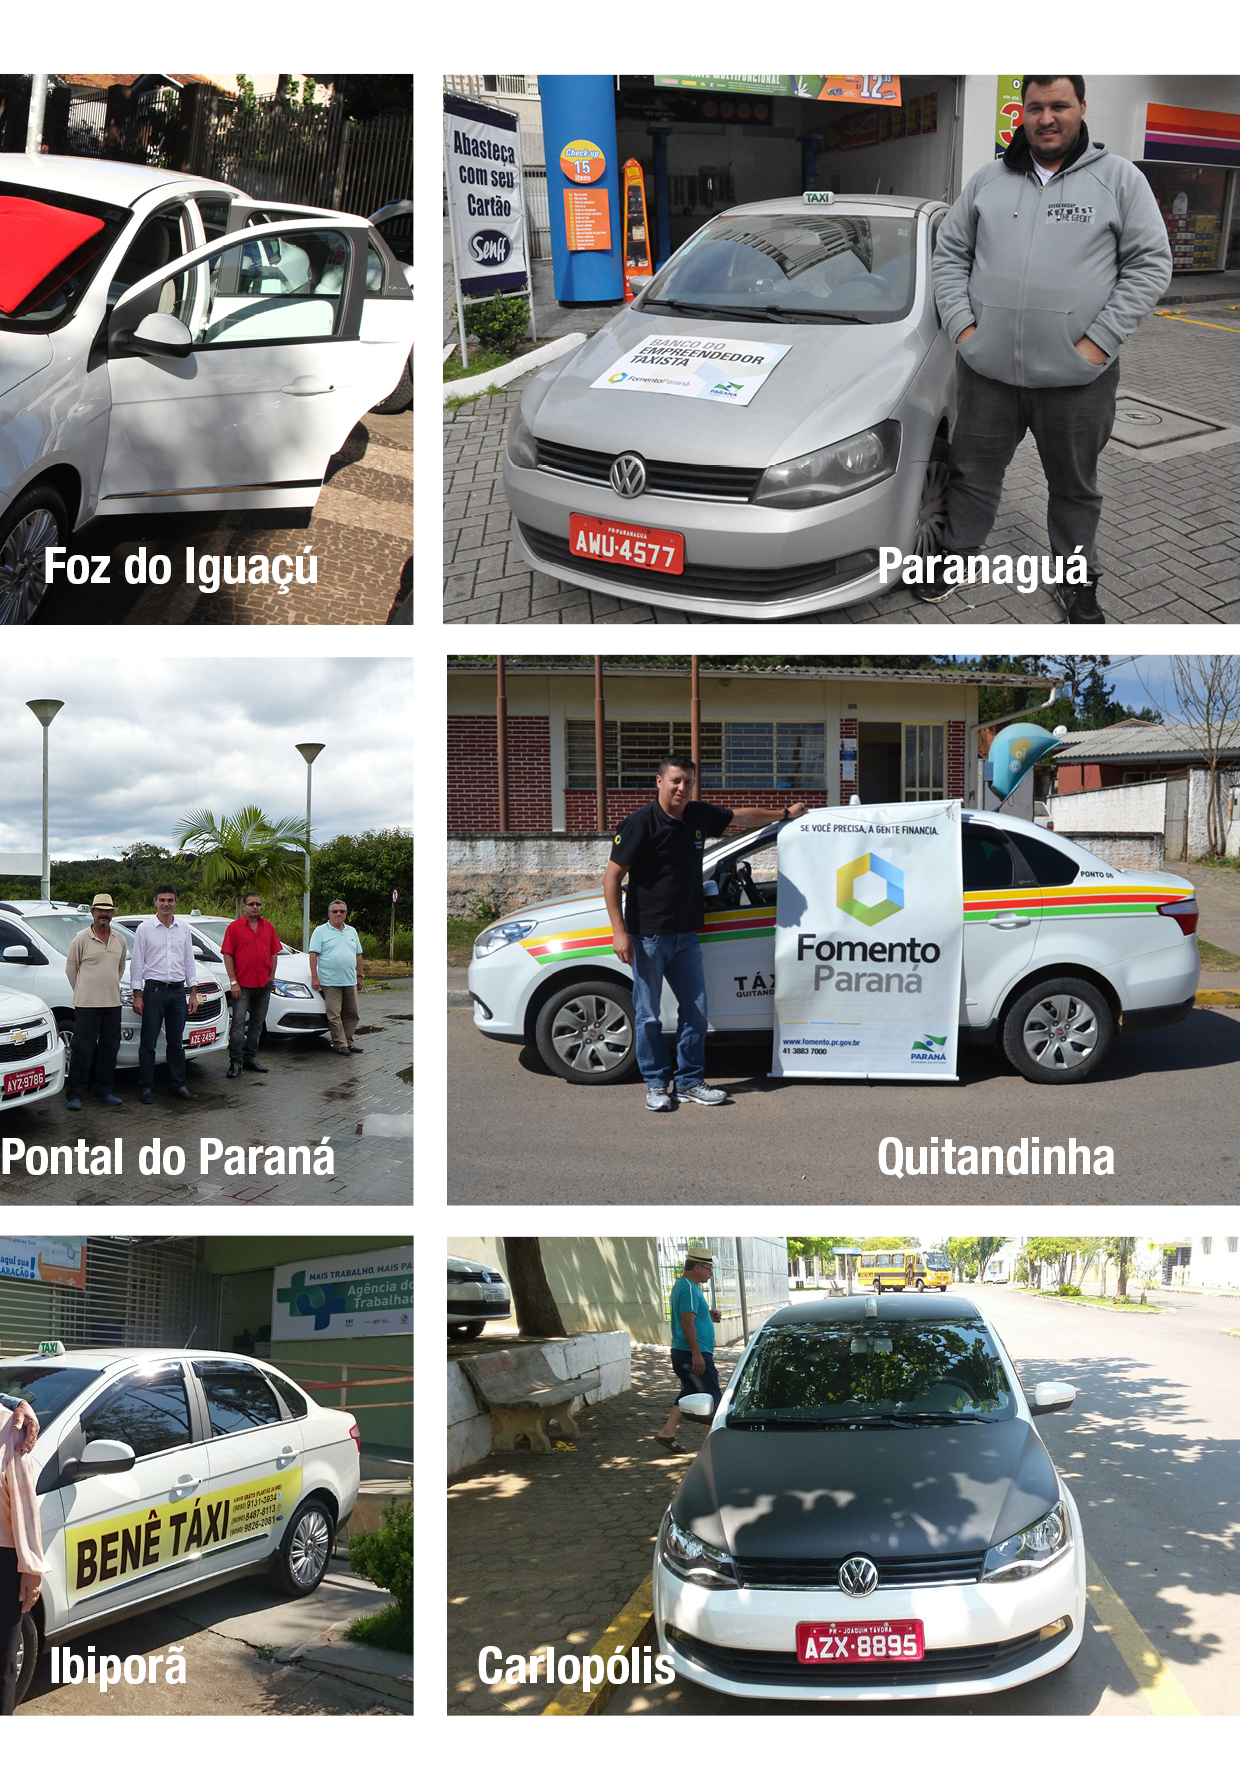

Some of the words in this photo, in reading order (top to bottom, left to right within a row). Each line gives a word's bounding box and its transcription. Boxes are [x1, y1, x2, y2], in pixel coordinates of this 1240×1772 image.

[454, 130, 515, 166] Abasteça
[574, 160, 590, 174] 15
[460, 165, 487, 186] com
[491, 171, 514, 188] seu
[805, 193, 830, 203] TAXI
[467, 194, 511, 217] Cartão
[472, 236, 507, 261] Senff
[649, 339, 701, 349] BANCO
[702, 341, 726, 350] DO
[630, 355, 690, 367] TAXISTA
[639, 347, 765, 365] EMPREENDEDOR
[1015, 748, 1026, 759] oi
[801, 824, 810, 832] SE
[812, 823, 831, 833] VOCÊ
[833, 824, 867, 834] PRECISA,
[868, 825, 874, 833] A
[876, 825, 900, 834] GENTE
[902, 826, 939, 835] FINANCIA.
[798, 934, 941, 964] Fomento
[814, 964, 922, 993] Paraná
[783, 1038, 860, 1047] www.fomento.pr.gov.br
[910, 1052, 946, 1060] PARANÁ
[0, 1256, 16, 1266] aqui
[310, 1273, 328, 1281] MAIS
[377, 1264, 399, 1273] MAIS
[347, 1283, 397, 1298] Agência
[41, 1342, 58, 1353] TAXI
[75, 1509, 162, 1590] BENÊ
[169, 1497, 231, 1557] TÁXI
